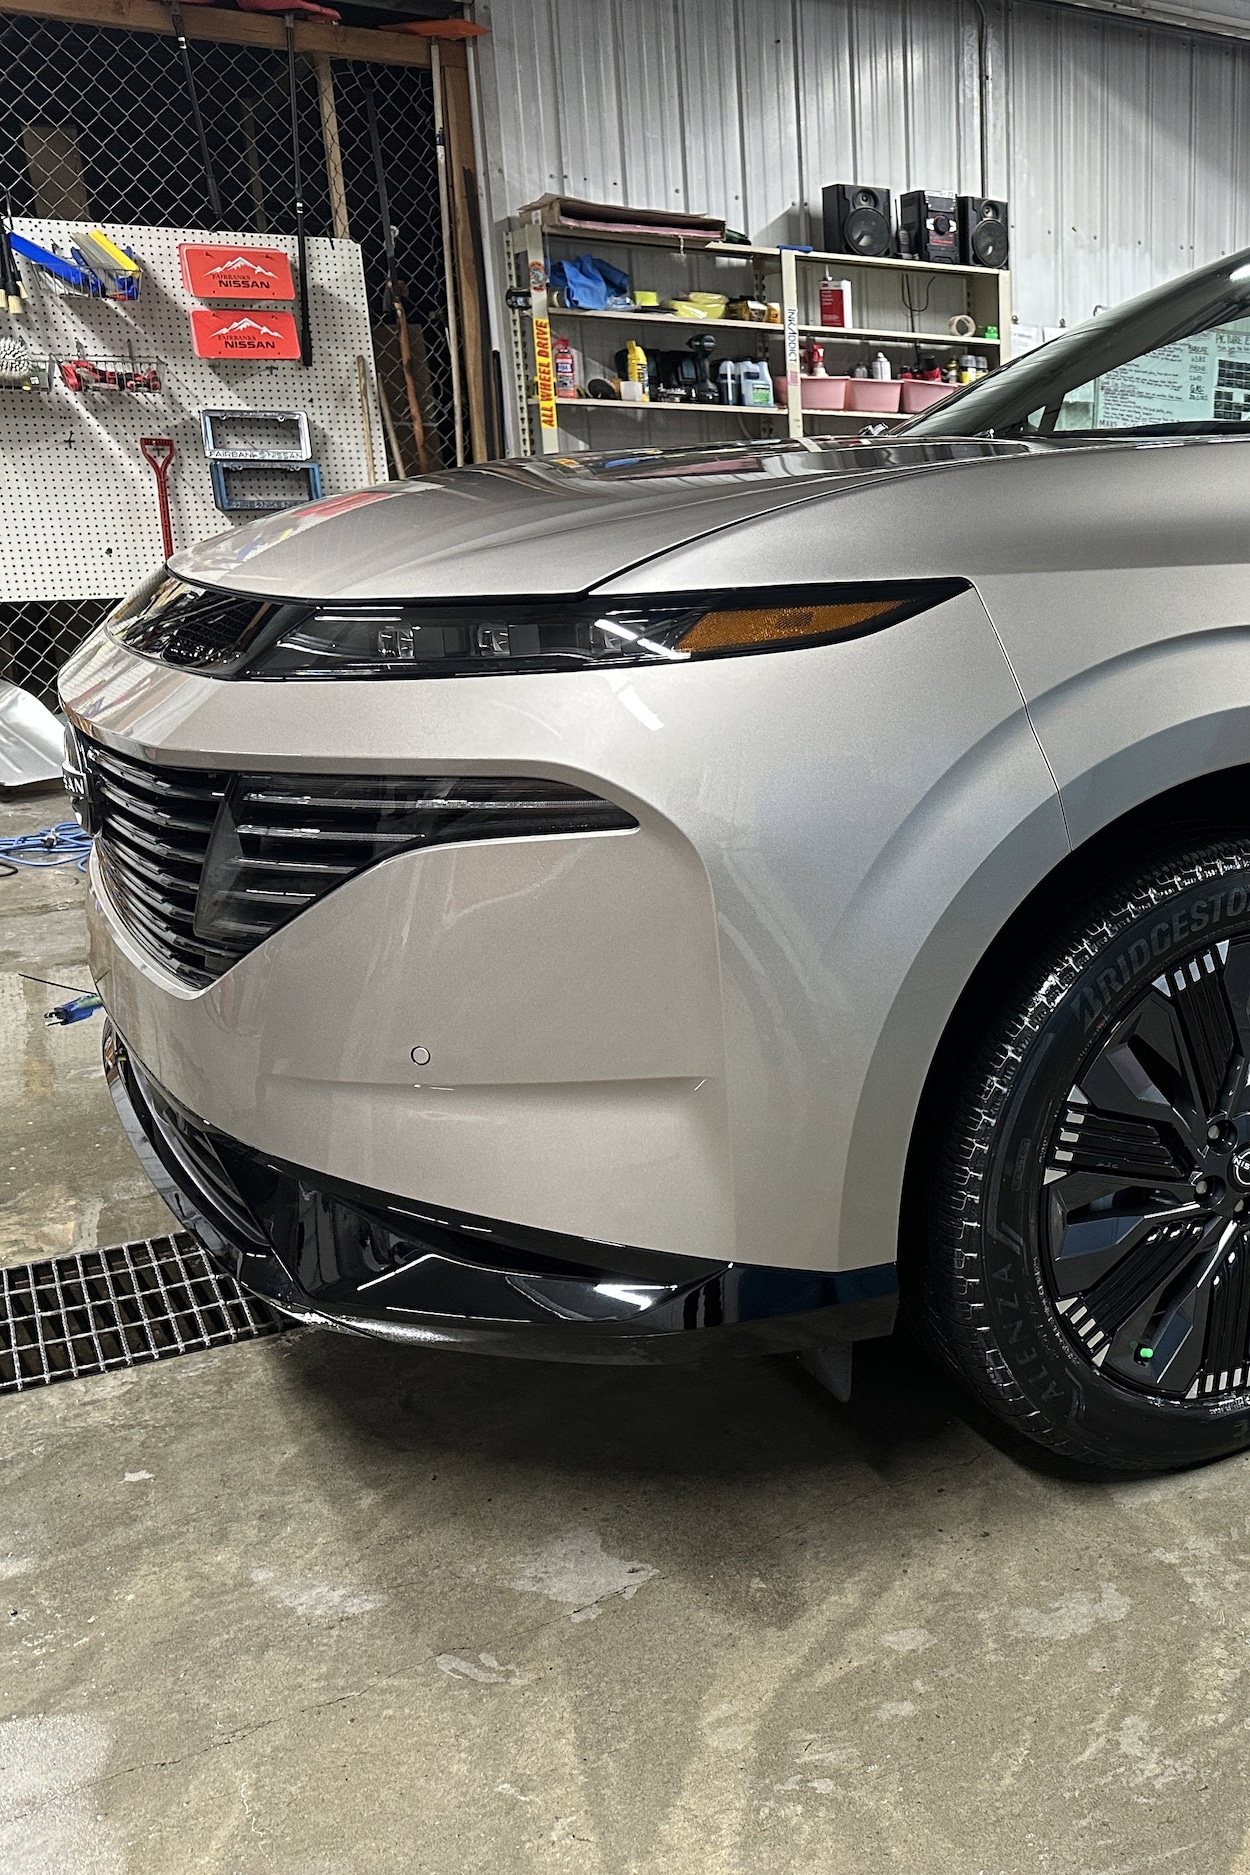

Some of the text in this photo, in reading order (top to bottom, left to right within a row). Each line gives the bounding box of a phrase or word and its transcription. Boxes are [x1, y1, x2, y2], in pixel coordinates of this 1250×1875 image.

[218, 280, 270, 288] NISSAN
[224, 340, 276, 349] NISSAN
[535, 319, 555, 427] ALL WHEEL DRIVE
[209, 450, 303, 459] FAIRBANKS NISSAN
[992, 1262, 1065, 1406] ALENZA
